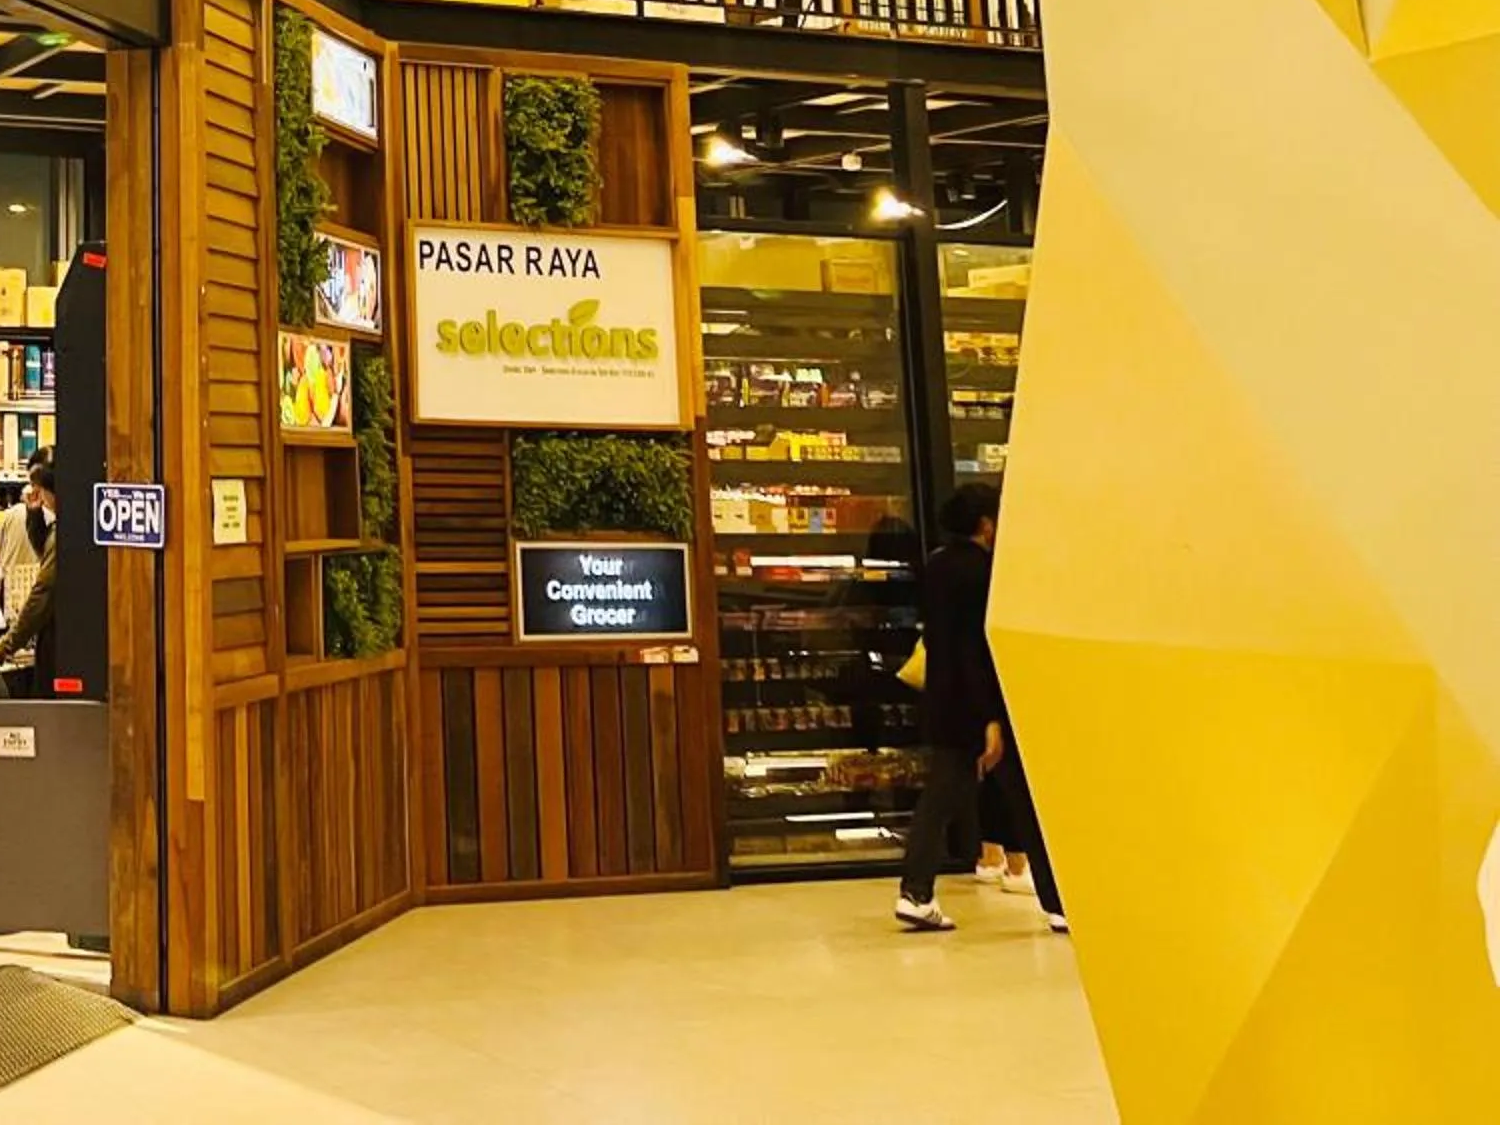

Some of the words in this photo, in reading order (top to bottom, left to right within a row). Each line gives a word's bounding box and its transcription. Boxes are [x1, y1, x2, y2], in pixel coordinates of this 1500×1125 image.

[419, 240, 515, 275] PASAR
[525, 246, 601, 279] RAYA
[435, 299, 659, 360] selections
[99, 499, 160, 534] OPEN
[579, 554, 624, 575] Your
[546, 579, 653, 601] Convenient
[570, 603, 636, 625] Grocer
